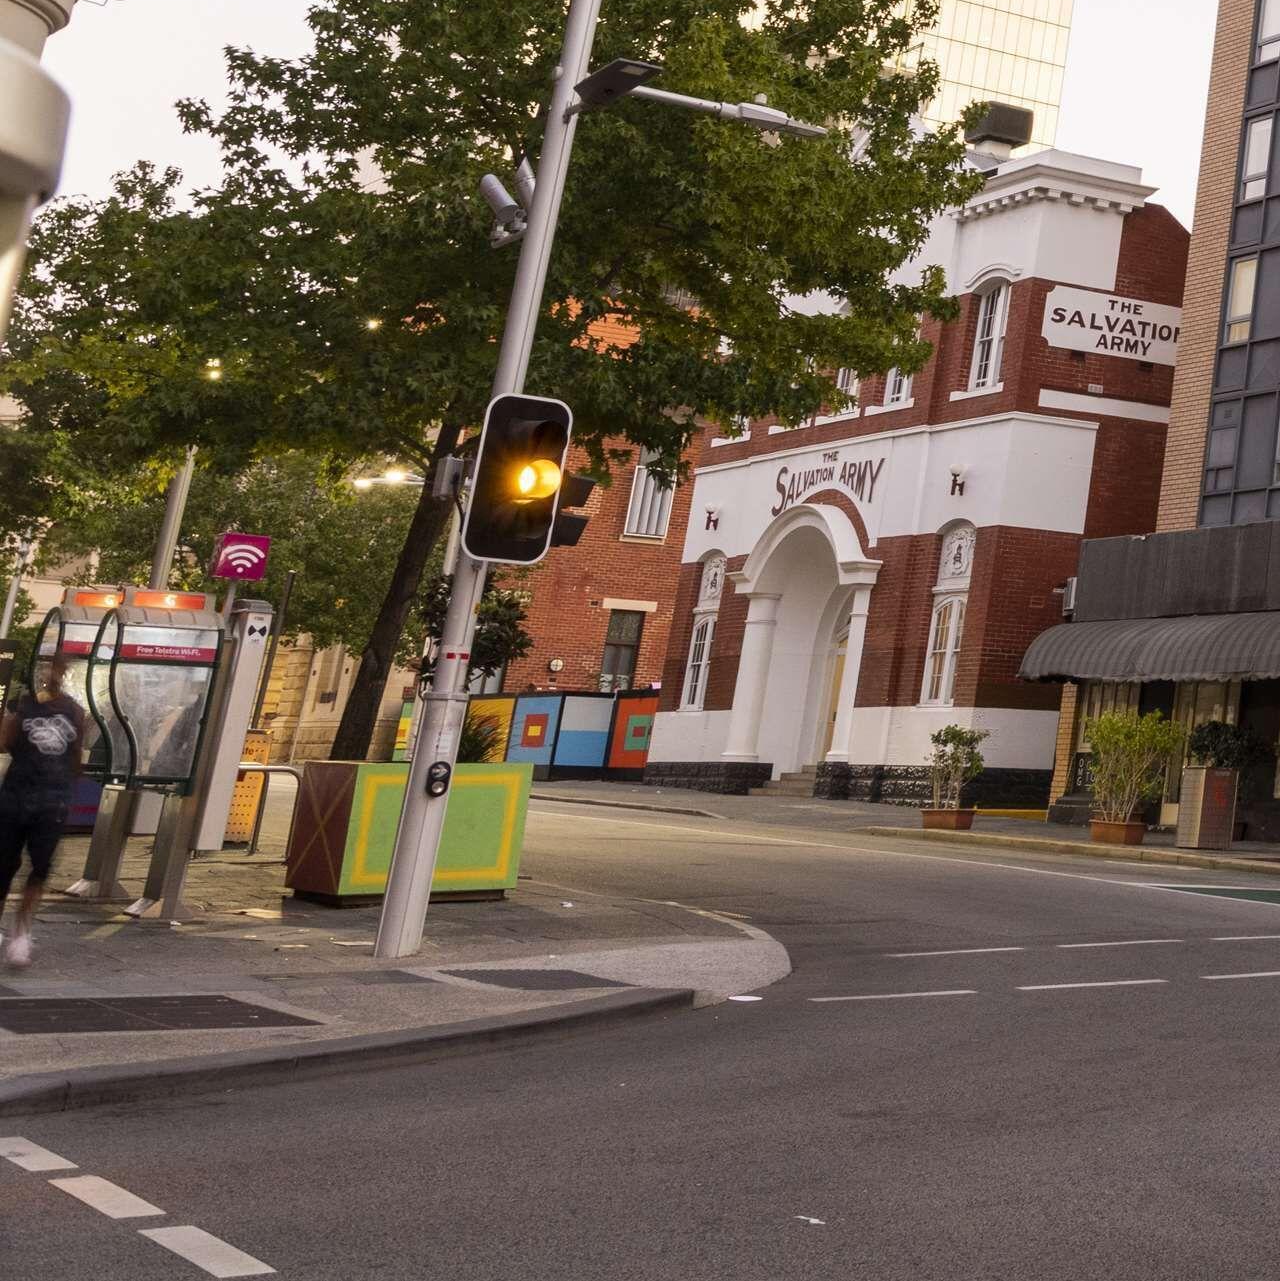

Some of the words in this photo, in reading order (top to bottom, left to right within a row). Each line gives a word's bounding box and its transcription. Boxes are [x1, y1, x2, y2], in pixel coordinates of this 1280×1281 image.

[1108, 299, 1143, 316] THE
[1095, 334, 1152, 357] ARMY
[822, 451, 840, 463] THE
[771, 466, 835, 517] SALVATION
[838, 458, 886, 504] ARMY
[136, 646, 154, 654] Free
[155, 646, 180, 655] Telstra
